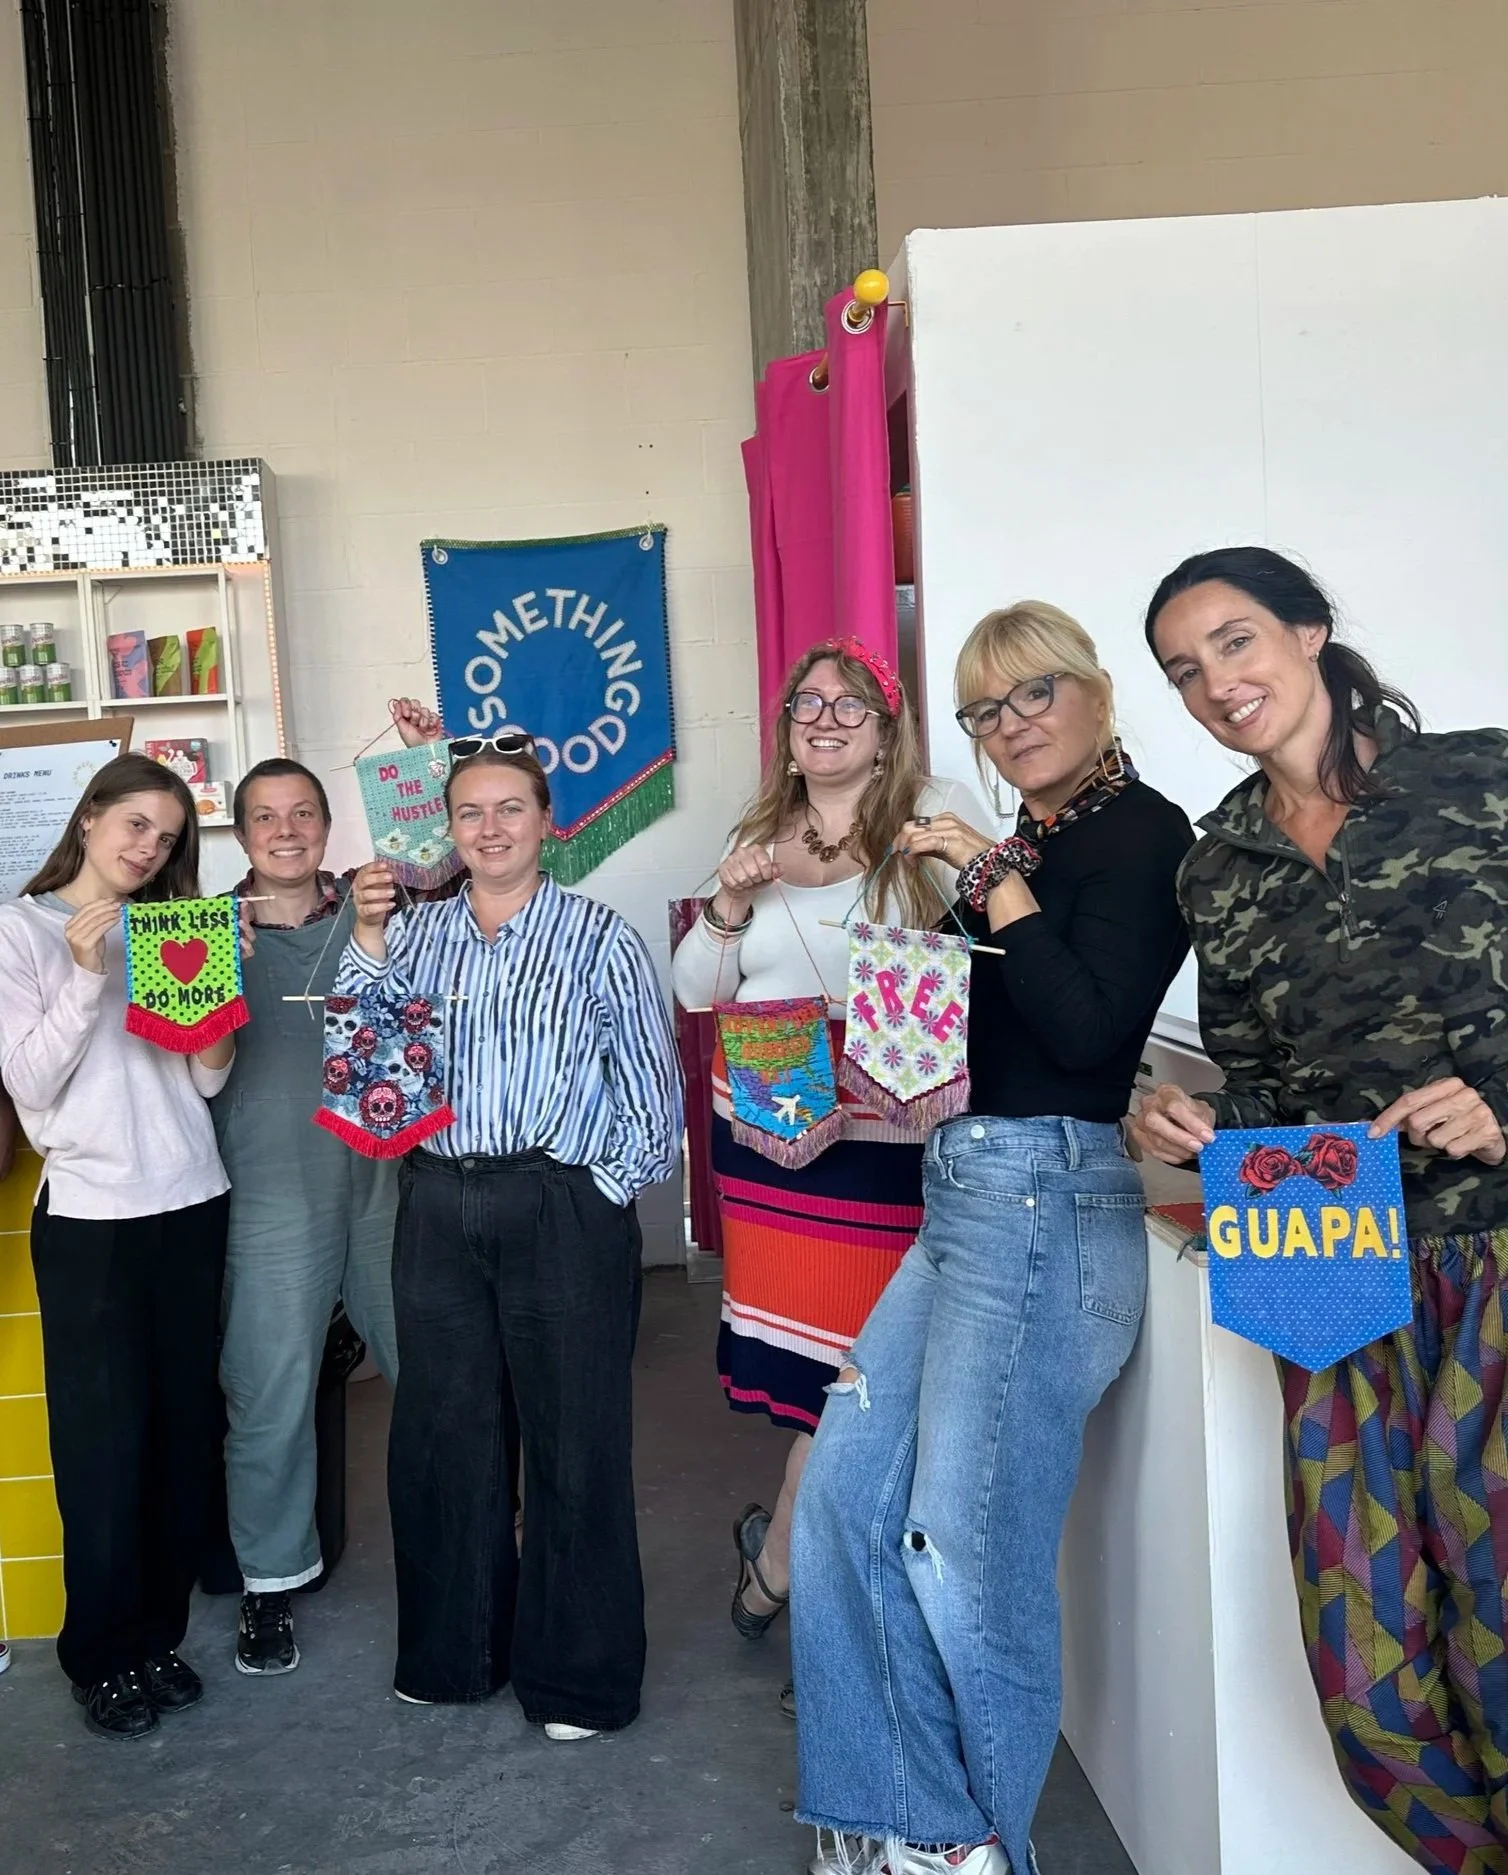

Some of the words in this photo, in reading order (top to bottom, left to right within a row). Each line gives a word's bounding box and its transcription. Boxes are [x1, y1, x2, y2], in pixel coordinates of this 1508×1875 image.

[464, 587, 643, 730] SOMETHING
[493, 714, 627, 775] OOD
[3, 770, 31, 780] DRINKS
[33, 769, 52, 777] MENU
[378, 764, 399, 782] DO
[396, 779, 423, 798] THE
[391, 796, 444, 822] HUSTLE
[129, 913, 182, 935] THINK
[188, 910, 230, 930] LESS
[144, 990, 170, 1009] DO
[177, 984, 226, 1006] MORE
[852, 969, 965, 1044] FREE
[1208, 1205, 1403, 1259] GUAPA!
